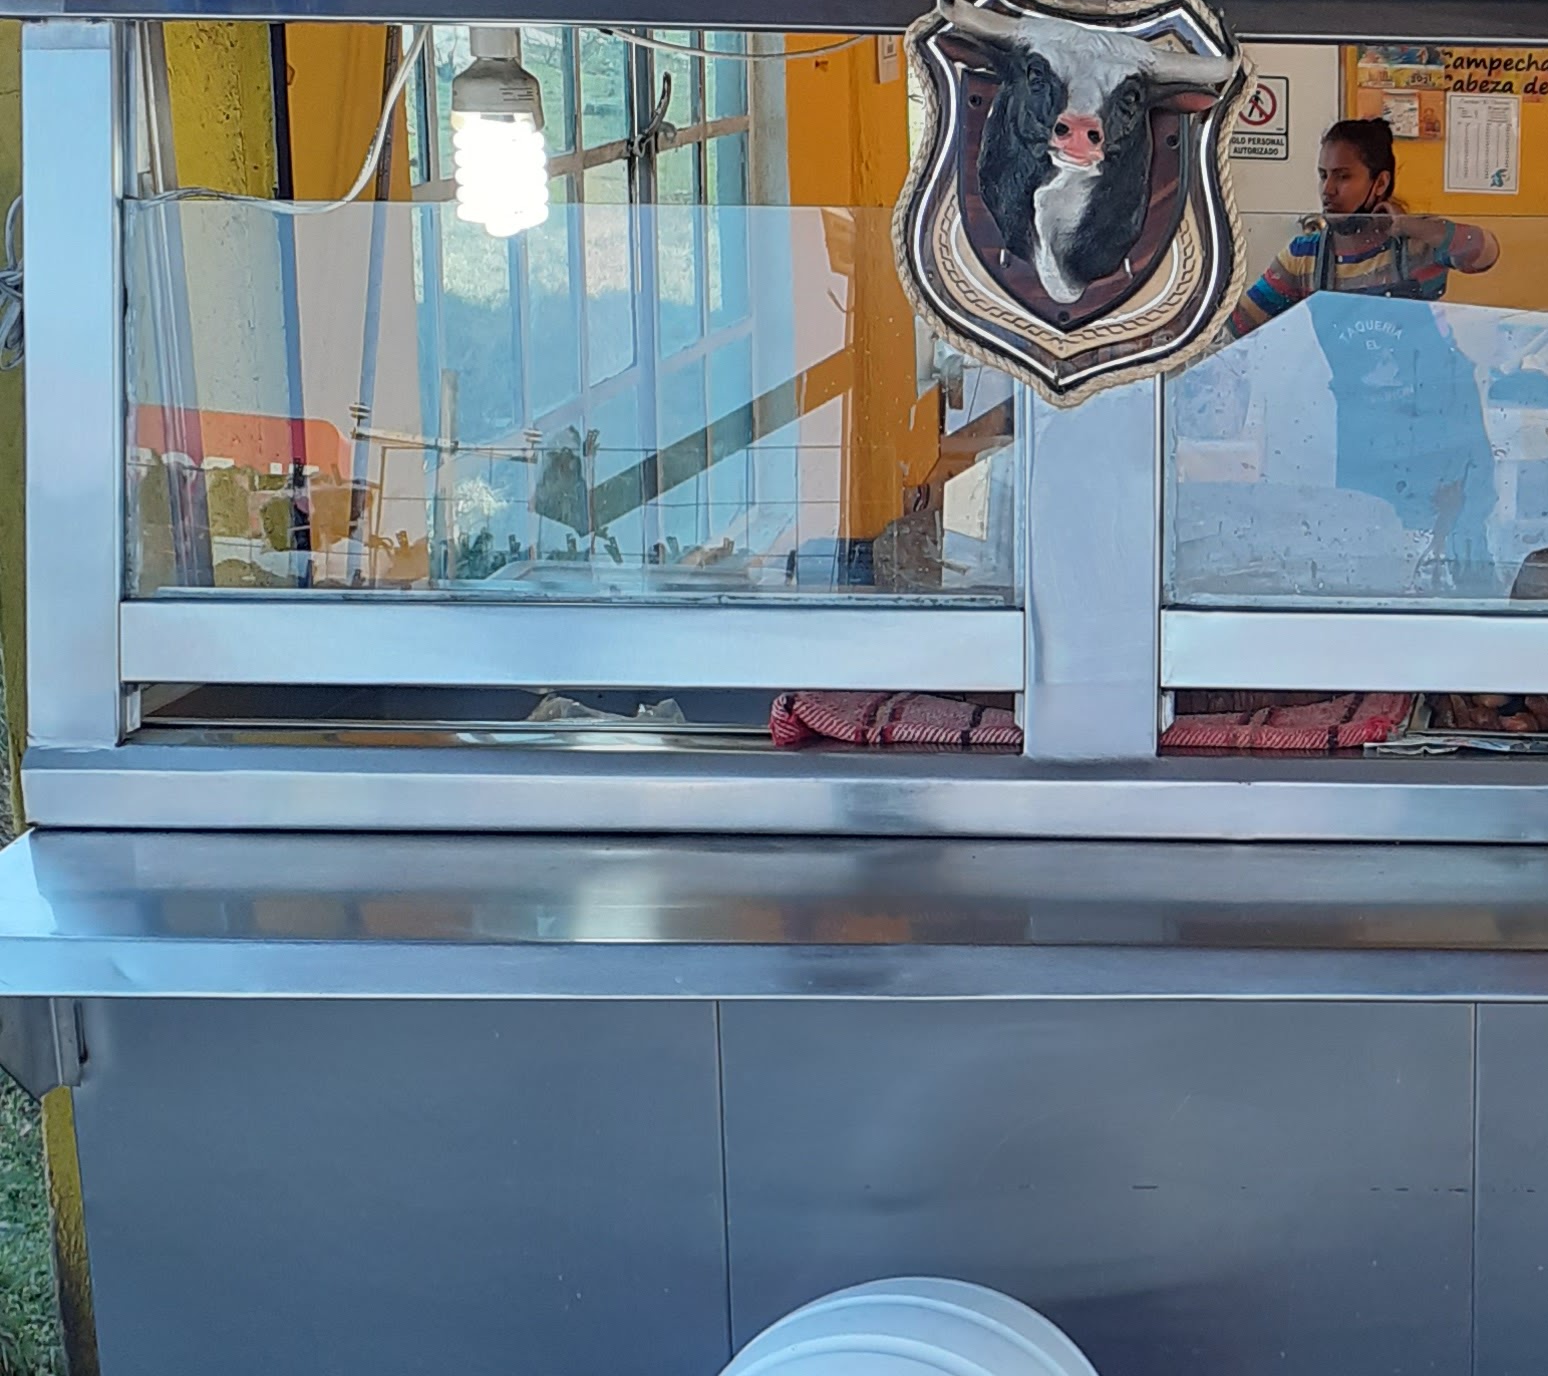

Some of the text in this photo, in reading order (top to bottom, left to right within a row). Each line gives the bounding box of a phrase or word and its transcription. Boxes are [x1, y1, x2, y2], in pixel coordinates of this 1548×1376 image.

[1247, 137, 1284, 146] PERSONAL
[1233, 146, 1279, 156] AUTORIZADO
[1339, 320, 1403, 343] TAQUERIA
